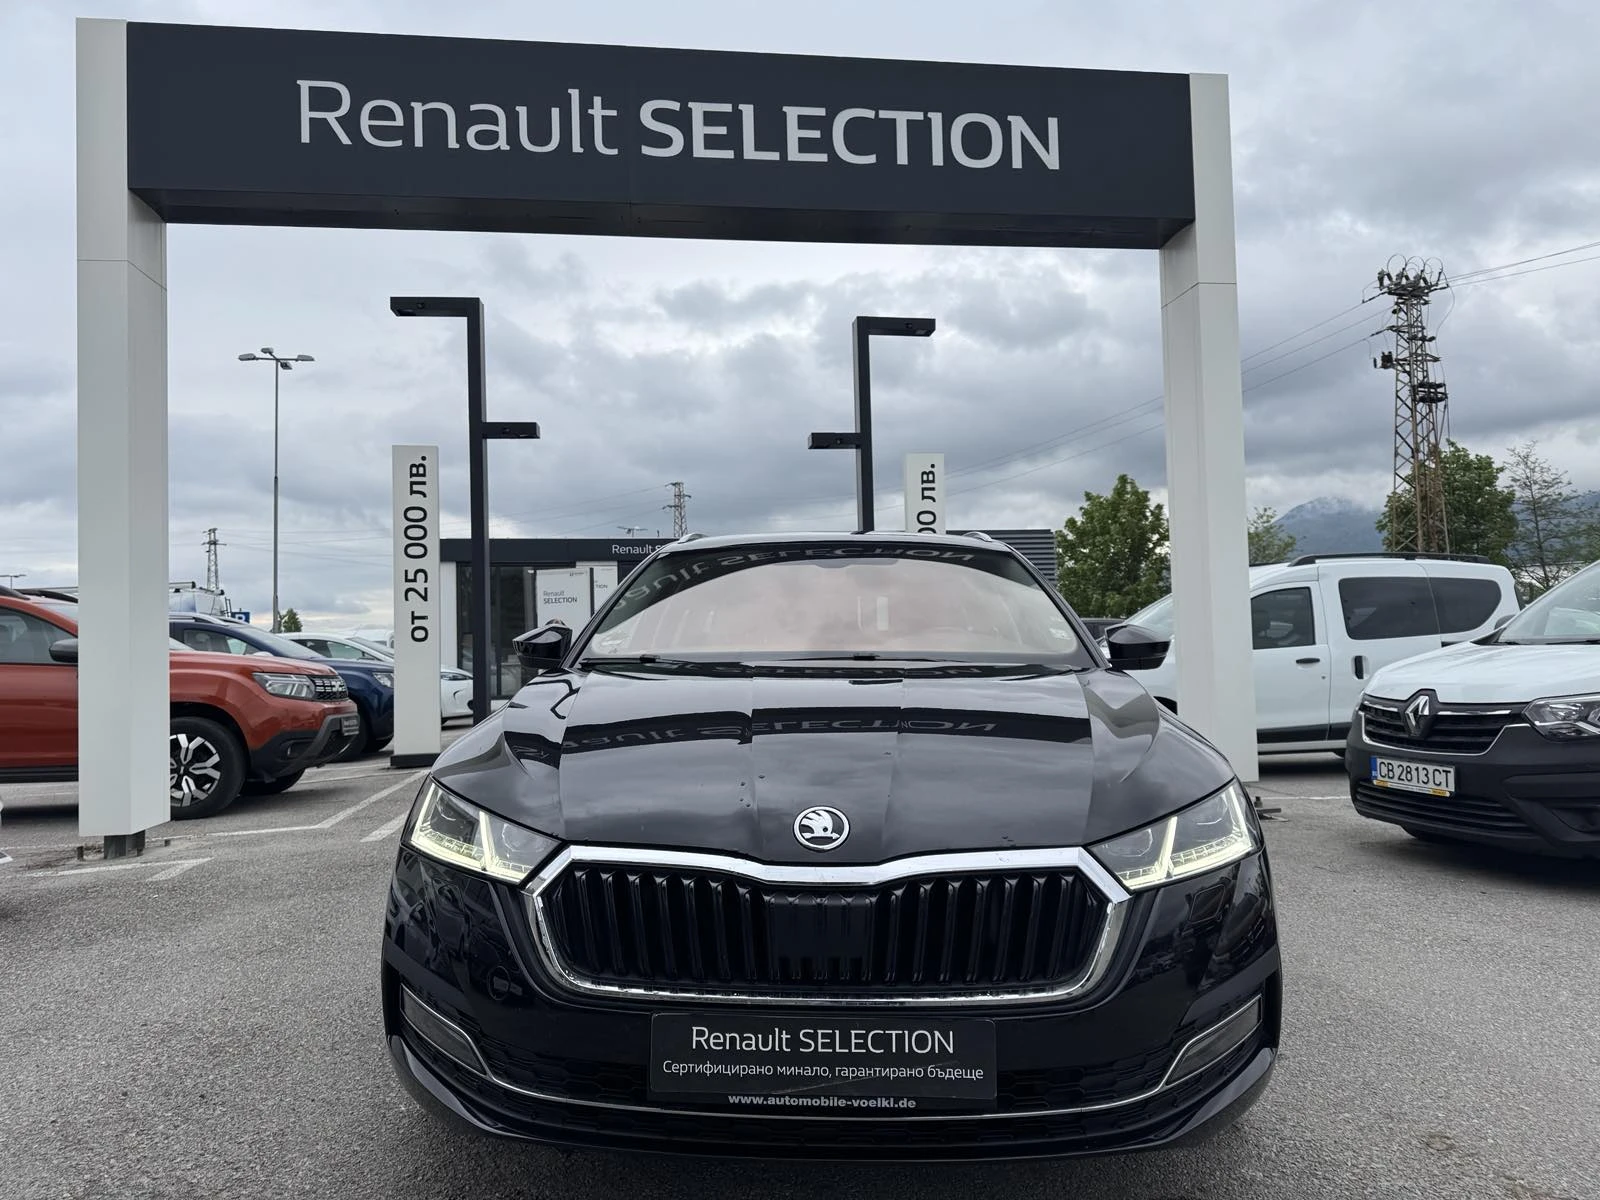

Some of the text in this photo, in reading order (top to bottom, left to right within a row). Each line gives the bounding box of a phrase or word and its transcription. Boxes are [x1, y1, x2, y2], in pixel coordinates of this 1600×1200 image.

[296, 79, 1061, 170] Renault SELECTION
[920, 463, 937, 503] лв.
[403, 455, 429, 643] от 25 000 лв.
[611, 544, 653, 555] Renault
[691, 1026, 954, 1054] Renault SELECTION
[663, 1060, 985, 1081] Сертифицирано минало, гарантирано бъдеще
[727, 1094, 917, 1109] www.automobile-voelkl.de
